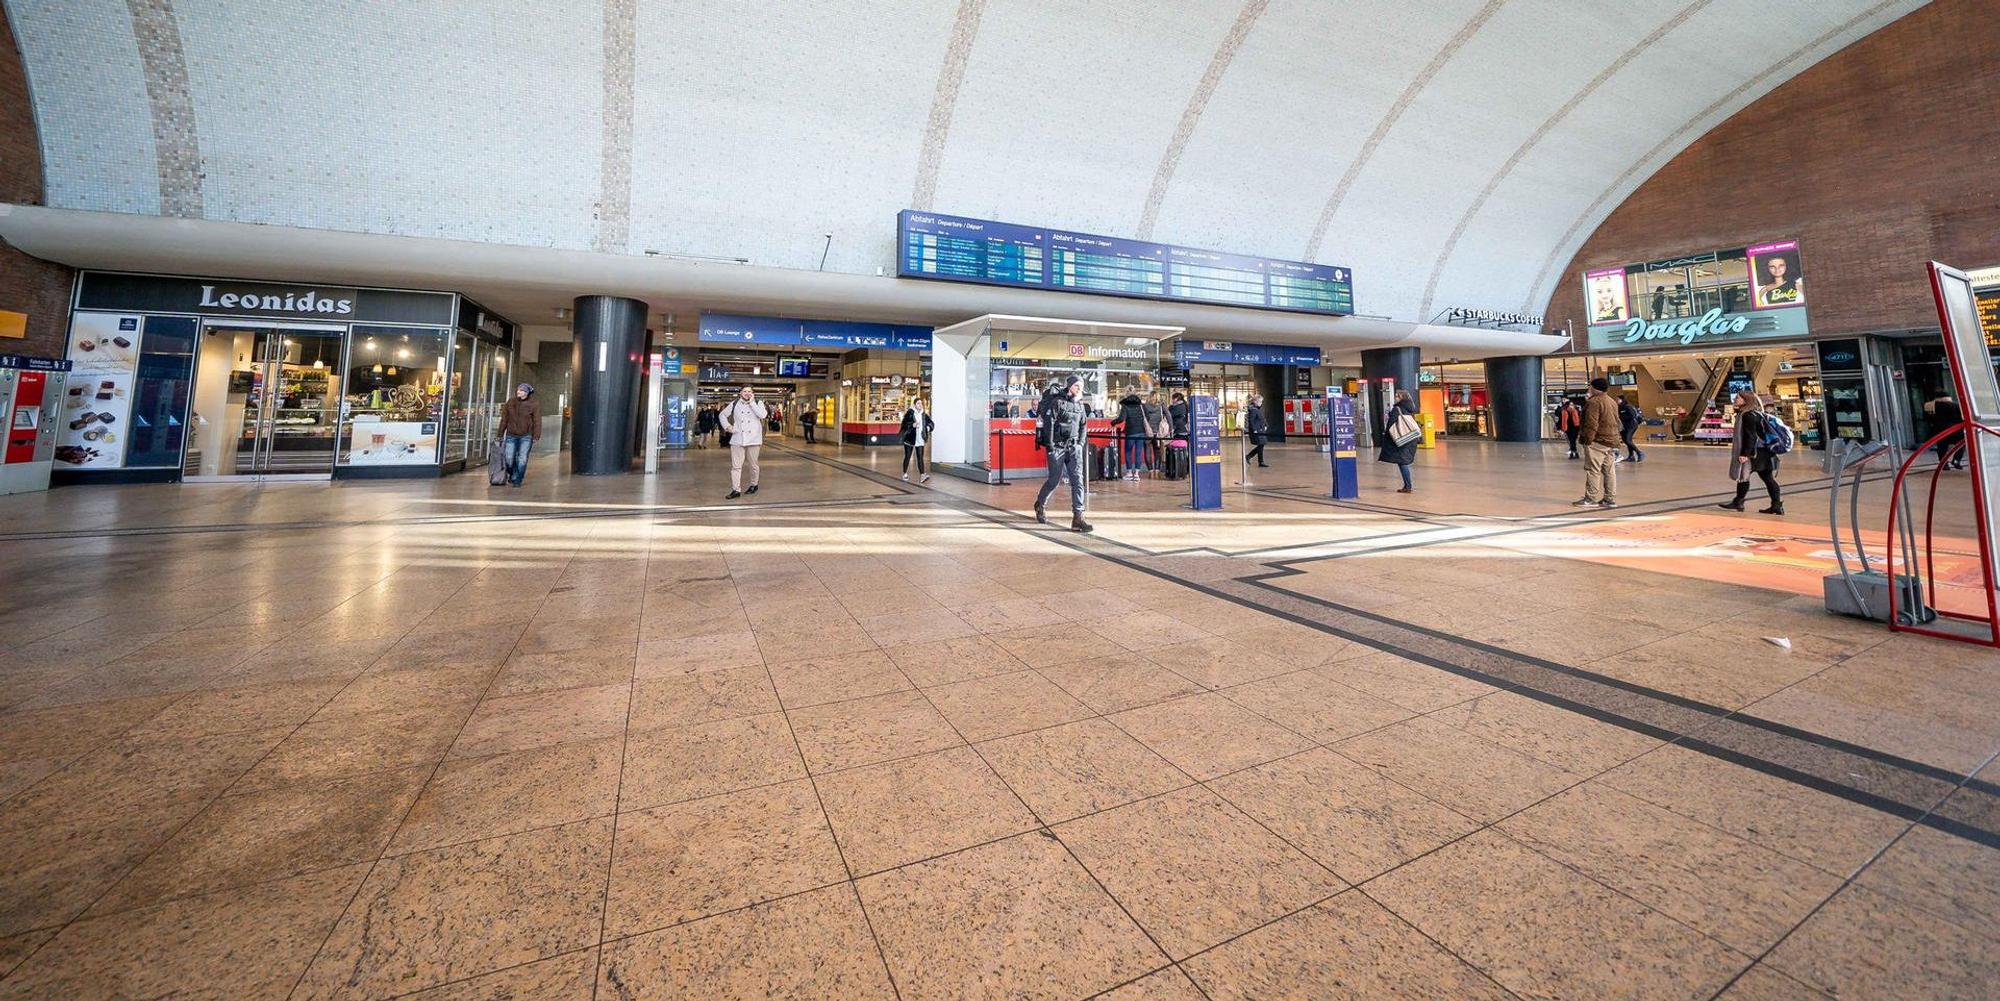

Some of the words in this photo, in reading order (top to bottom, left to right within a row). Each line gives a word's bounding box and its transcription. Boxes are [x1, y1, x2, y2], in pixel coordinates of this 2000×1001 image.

[910, 214, 935, 224] Abfahrt
[937, 219, 963, 229] Departure
[1052, 234, 1074, 243] Abfahrt
[199, 285, 353, 314] Leonidas
[1466, 308, 1515, 324] STARBUCKS
[1515, 314, 1545, 327] COFFEE
[1623, 307, 1751, 345] Douglas
[1070, 345, 1084, 356] DB
[1088, 346, 1147, 359] Information
[872, 376, 890, 384] Snack
[904, 377, 920, 386] Stop
